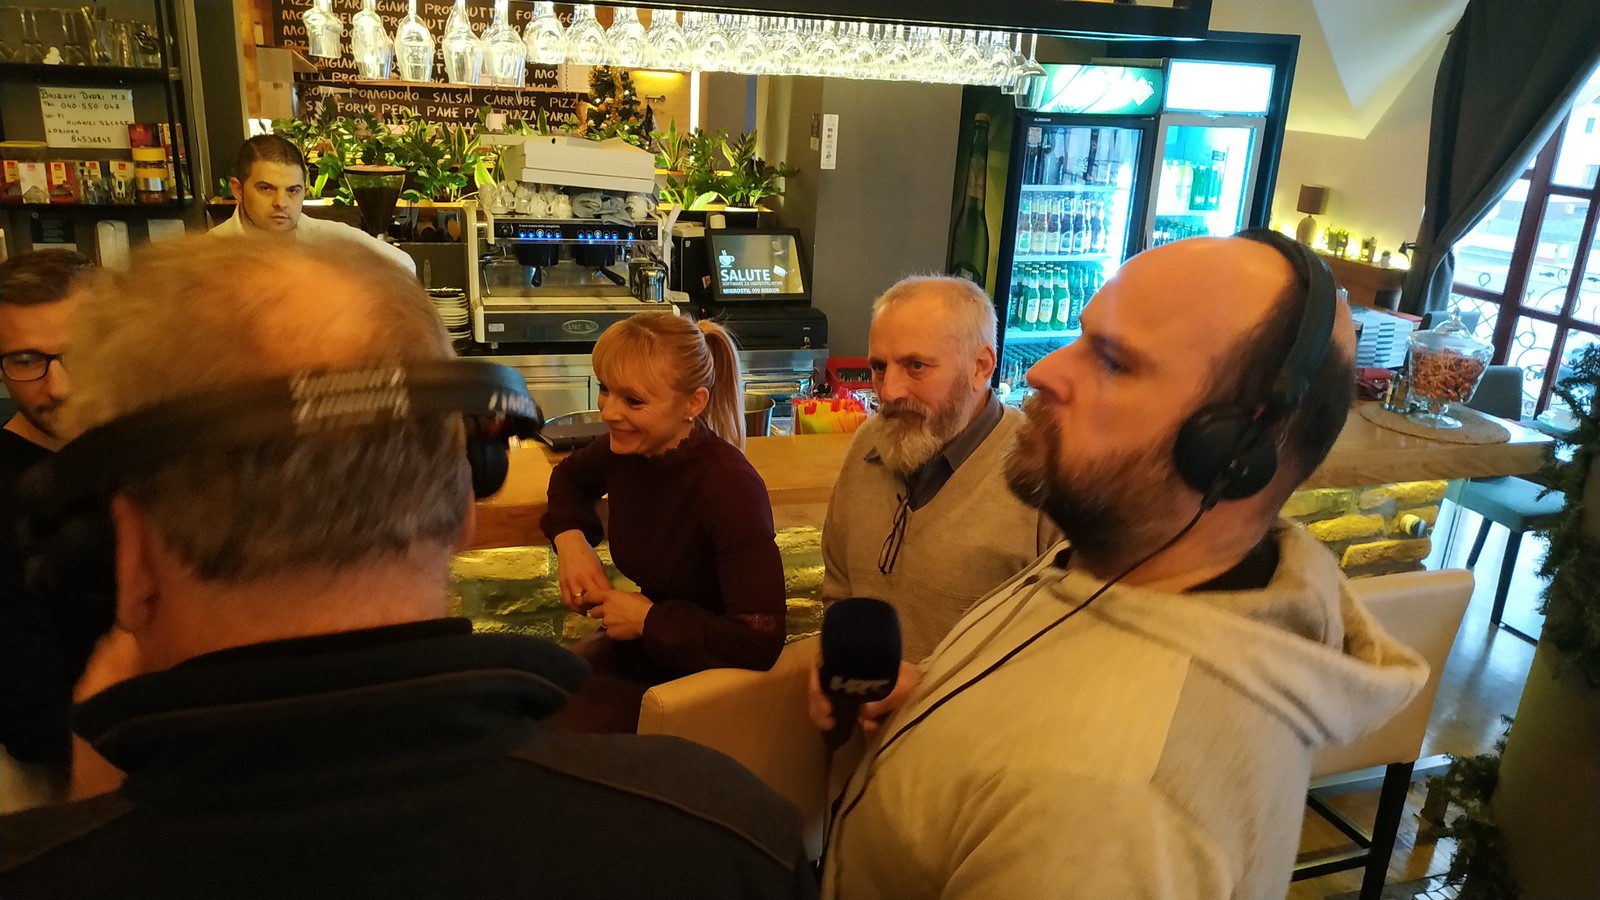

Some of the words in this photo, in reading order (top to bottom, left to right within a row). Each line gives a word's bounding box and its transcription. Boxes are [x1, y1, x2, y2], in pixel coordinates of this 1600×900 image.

[349, 87, 419, 101] POMODORO
[433, 92, 471, 104] SALSA
[483, 94, 537, 106] CARRUBE
[427, 105, 459, 118] PANE
[720, 269, 771, 281] SALUTE
[1071, 299, 1080, 317] PAN
